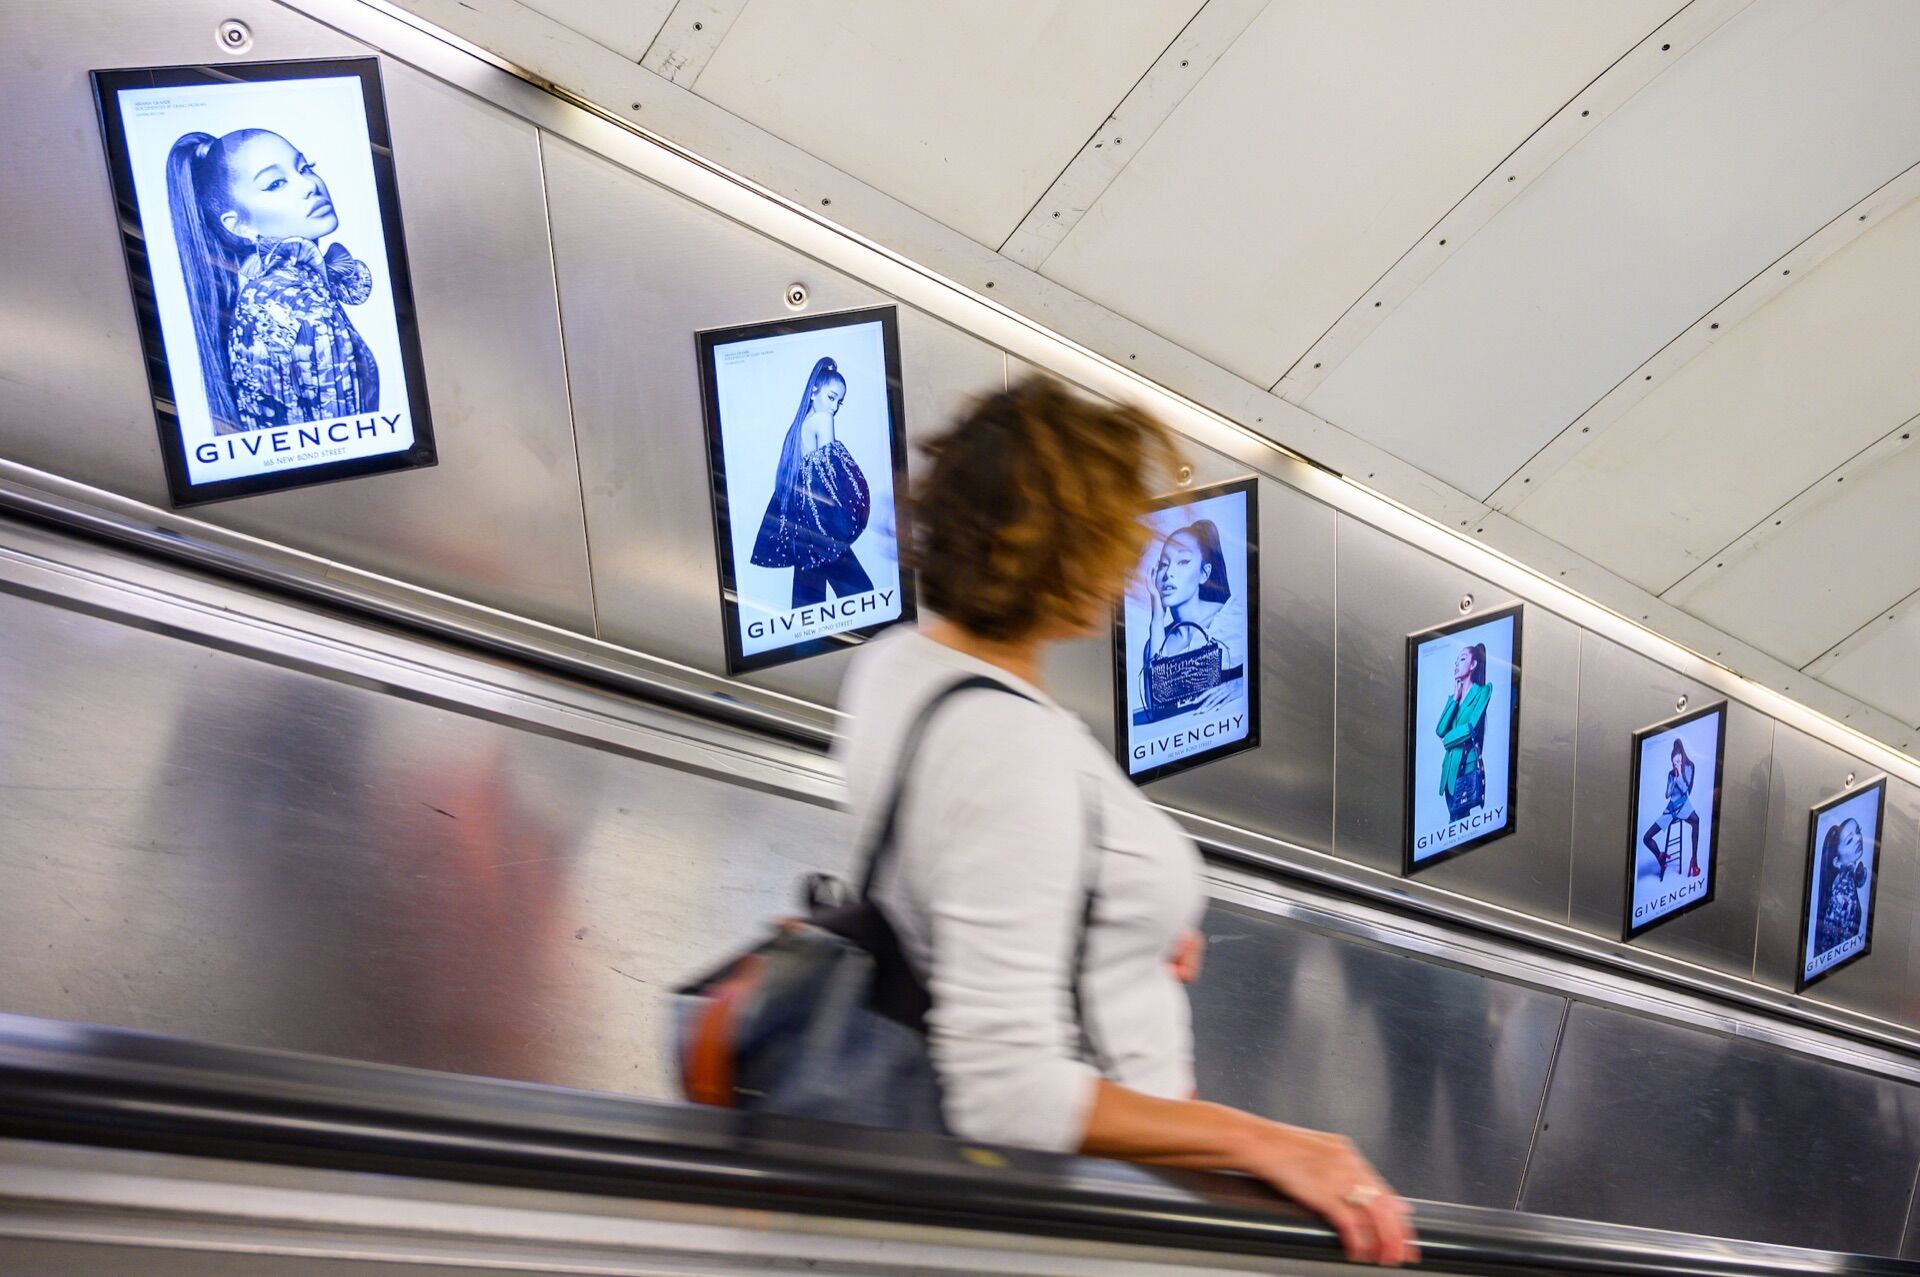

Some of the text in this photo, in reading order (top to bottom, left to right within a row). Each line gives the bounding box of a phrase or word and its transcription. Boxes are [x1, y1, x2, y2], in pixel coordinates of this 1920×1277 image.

[195, 413, 401, 464] GIVENCHY
[277, 455, 295, 465] NEW
[297, 451, 319, 462] BOND
[321, 447, 346, 459] STREET
[747, 590, 894, 639] GIVENCHY
[1133, 714, 1244, 760] GIVENCHY
[1417, 806, 1504, 849] GIVENCHY
[1634, 878, 1705, 918] GIVENCHY
[1806, 933, 1864, 972] GIVENCHY
